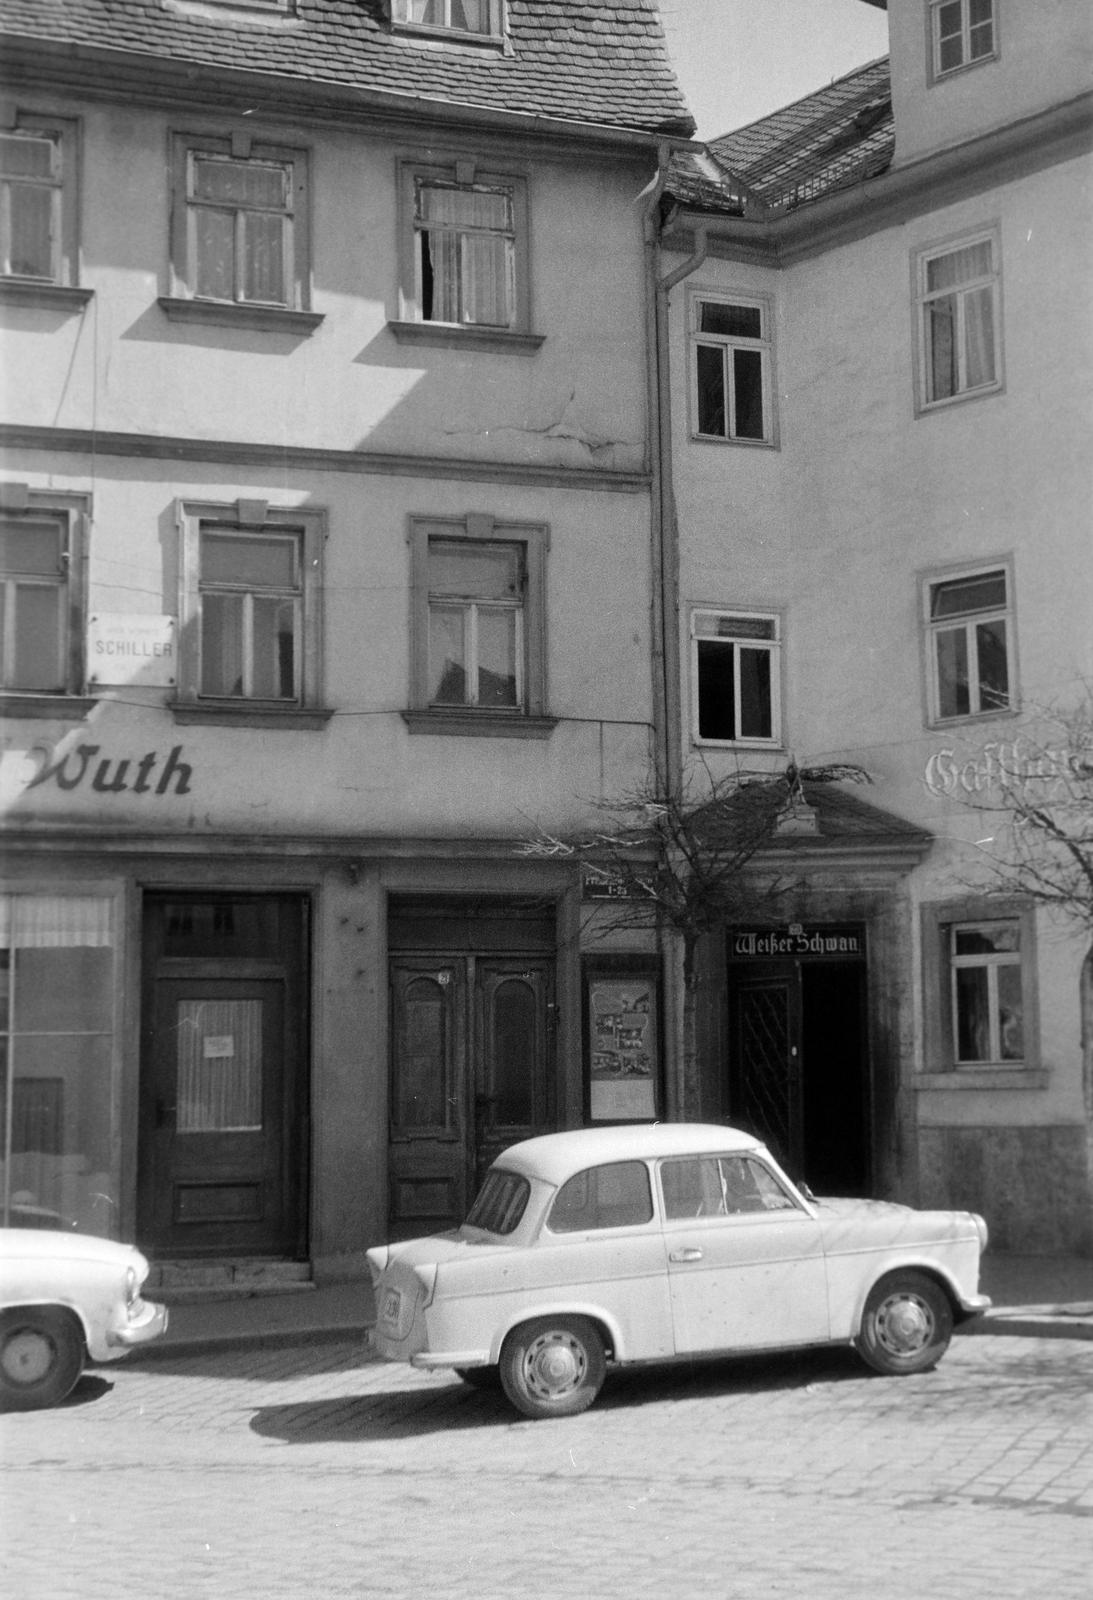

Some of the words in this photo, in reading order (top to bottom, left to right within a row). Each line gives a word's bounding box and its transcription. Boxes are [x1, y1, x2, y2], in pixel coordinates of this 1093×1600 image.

[95, 639, 173, 657] SCHILLER
[25, 744, 192, 795] Wuth
[735, 932, 793, 955] Weißer
[795, 931, 858, 954] Schwan
